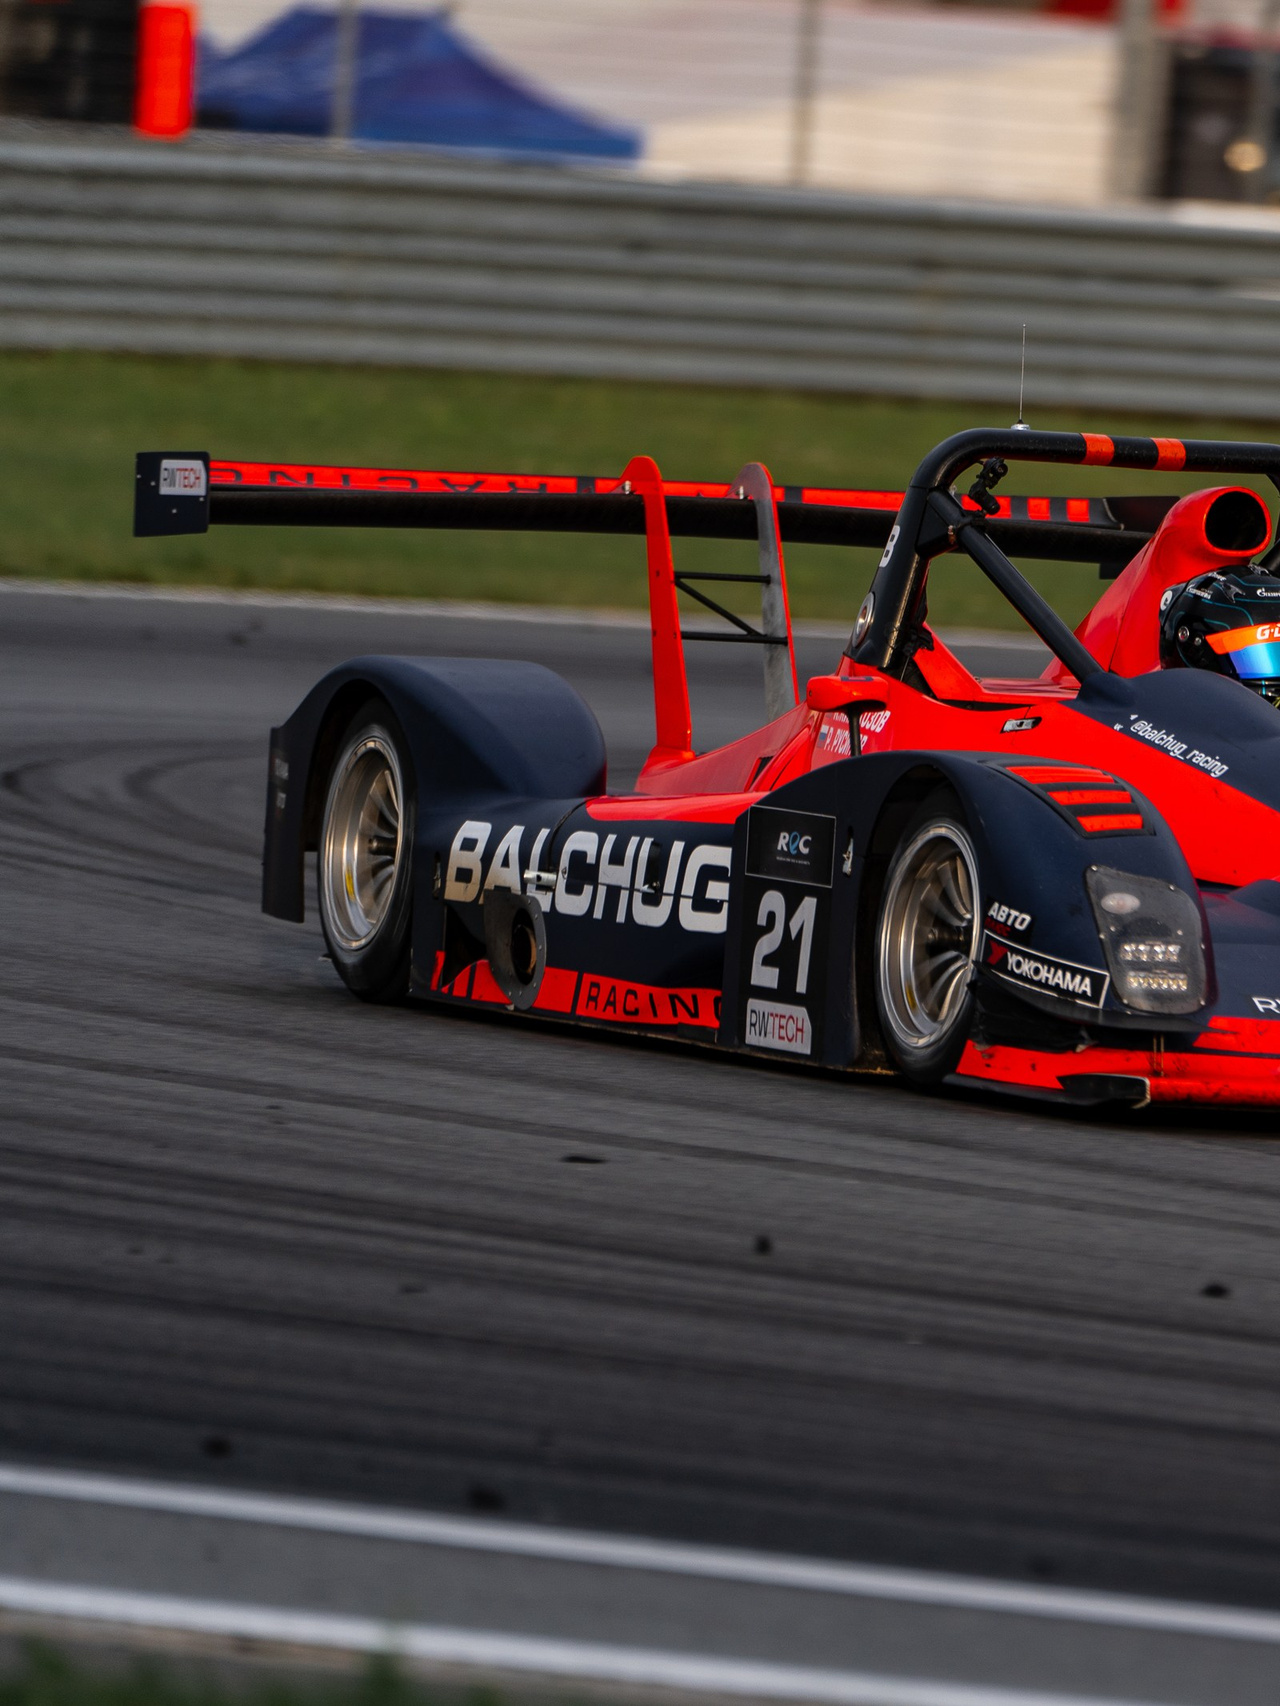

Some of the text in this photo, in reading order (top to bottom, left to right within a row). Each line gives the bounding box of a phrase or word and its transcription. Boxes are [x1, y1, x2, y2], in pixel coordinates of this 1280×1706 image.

[1130, 720, 1229, 778] @balchug_racing
[444, 820, 732, 934] BALCHUG
[750, 889, 817, 994] 21
[987, 901, 1032, 931] АВТО
[1007, 950, 1092, 997] YOKOHAMA
[749, 1009, 805, 1044] RWTECH
